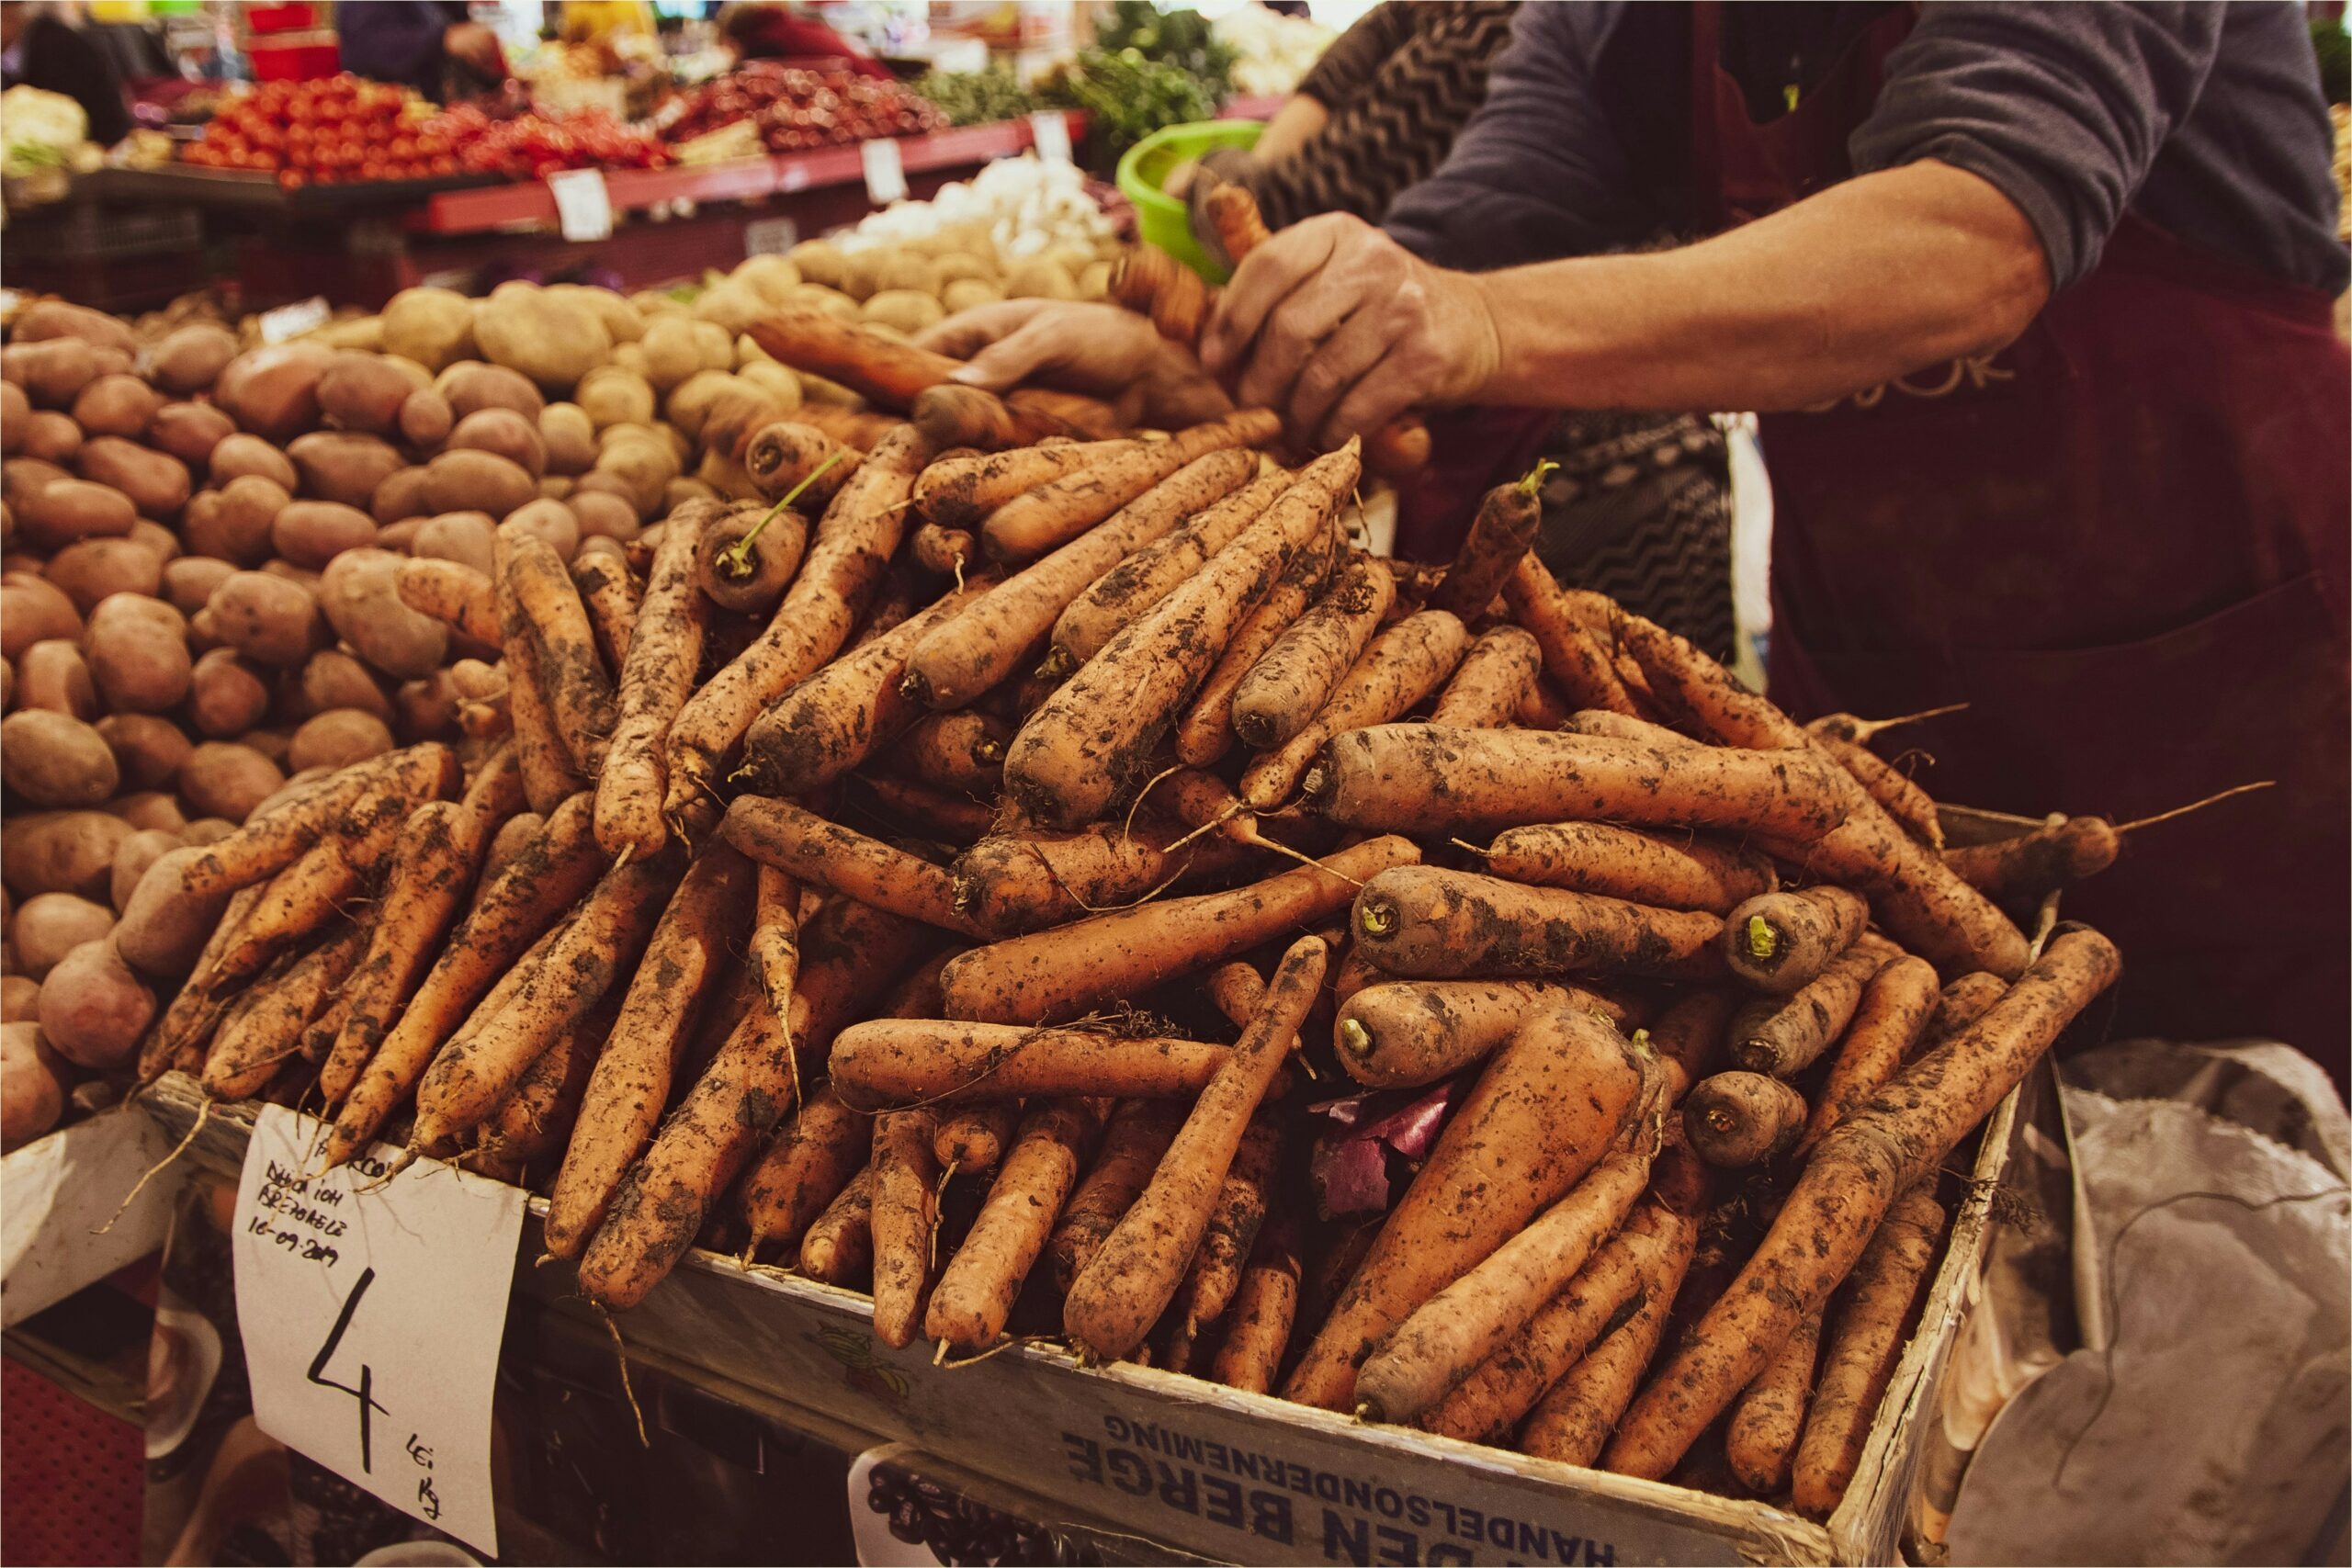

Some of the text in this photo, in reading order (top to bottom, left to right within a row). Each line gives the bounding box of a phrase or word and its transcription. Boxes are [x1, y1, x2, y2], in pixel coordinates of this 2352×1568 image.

[307, 1267, 390, 1474] 4
[1062, 1431, 1294, 1546] BERGE
[1103, 1415, 1614, 1567] HANDELSONDERNEMING
